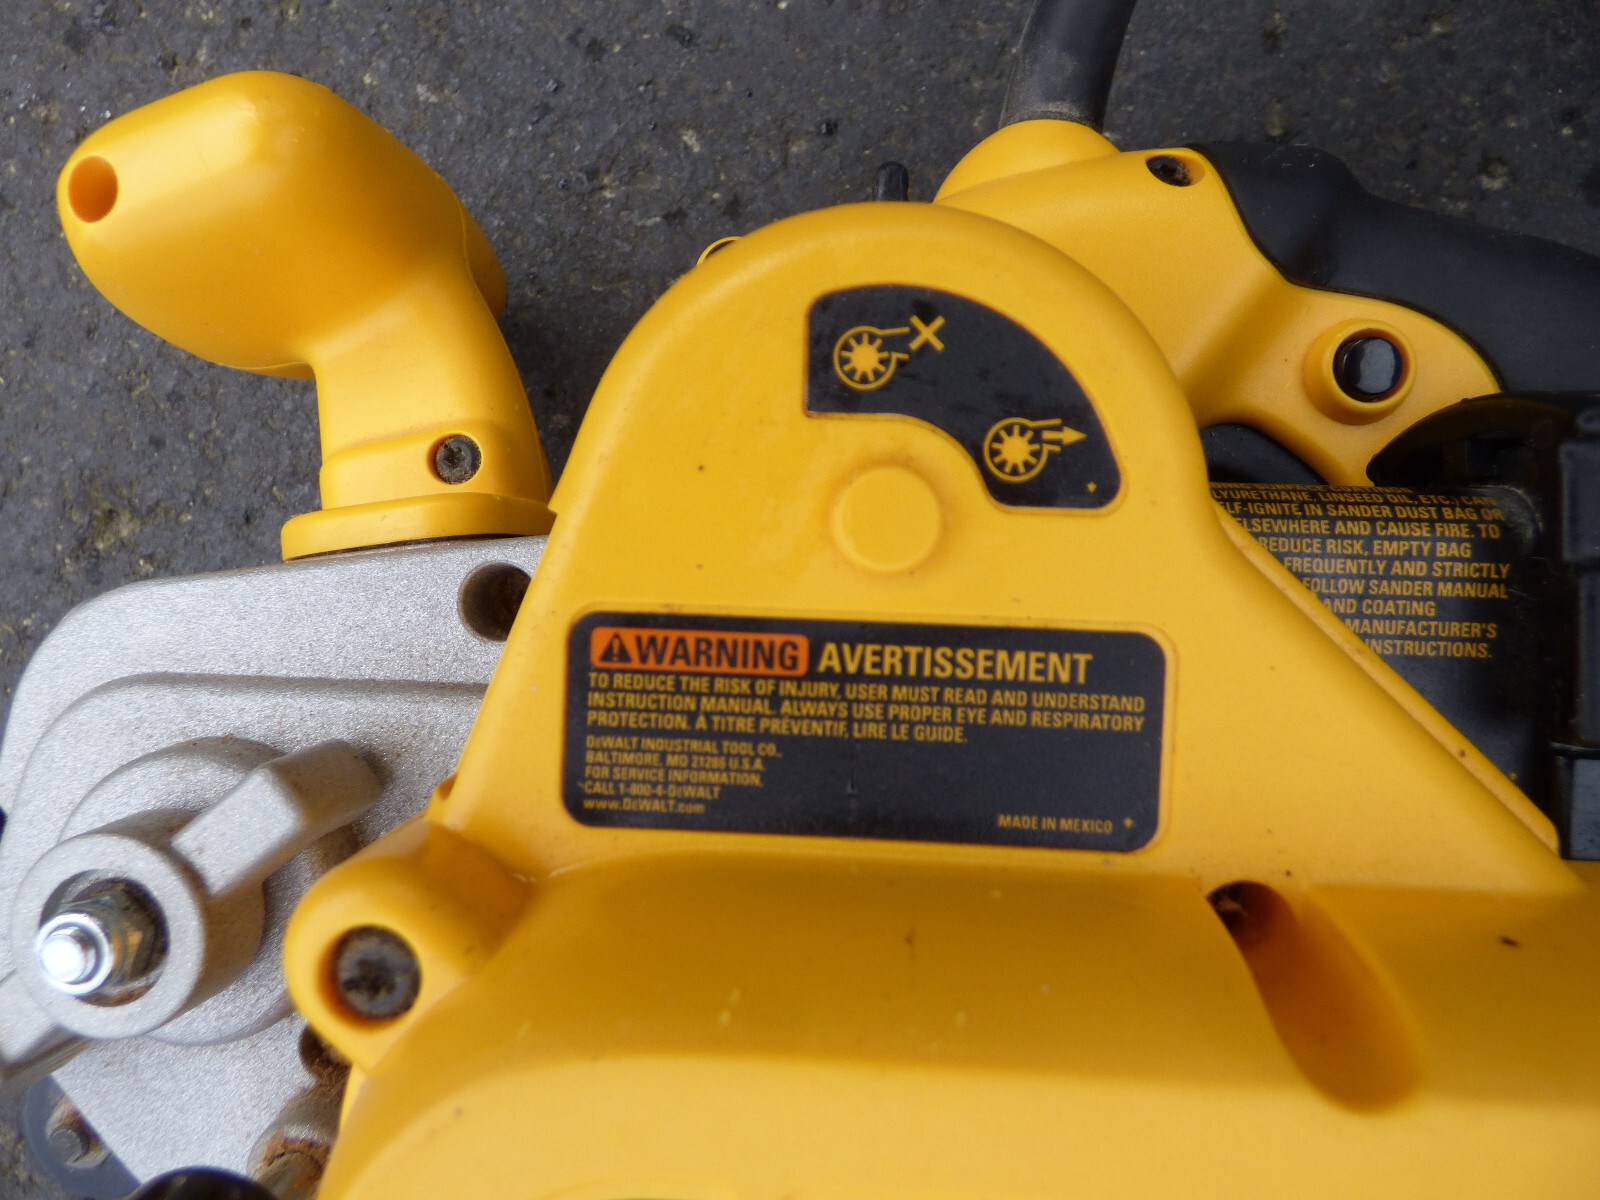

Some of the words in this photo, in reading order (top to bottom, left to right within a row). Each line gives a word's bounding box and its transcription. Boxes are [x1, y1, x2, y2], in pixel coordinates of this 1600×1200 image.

[1319, 491, 1383, 503] LINSEED
[1386, 494, 1418, 504] OIL,
[1303, 503, 1323, 516] IN
[1326, 504, 1392, 518] SANDER
[1394, 506, 1437, 519] DUST
[1441, 507, 1478, 520] BAG
[1480, 508, 1505, 521] OR
[1236, 518, 1330, 535] LSEWHERE
[1335, 520, 1371, 536] AND
[1375, 521, 1431, 537] CAUSE
[1435, 522, 1475, 539] FIRE.
[1477, 524, 1500, 539] TO
[1258, 536, 1321, 553] REDUCE
[1326, 538, 1369, 556] RISK,
[1373, 540, 1431, 557] EMPTY
[1436, 542, 1472, 558] BAG
[1283, 556, 1388, 576] FREQUENTLY
[1390, 560, 1427, 576] AND
[1431, 561, 1510, 579] STRICTLY
[1302, 577, 1365, 594] FOLLOW
[1368, 579, 1433, 596] SANDER
[1437, 581, 1508, 599] MANUAL
[1323, 597, 1357, 614] AND
[1362, 599, 1436, 617] COATING
[1344, 618, 1498, 638] MANUFACTURER'S
[635, 634, 799, 671] WARNING
[816, 642, 1093, 684] AVERTISSEMENT
[588, 672, 609, 689] TO
[612, 673, 676, 692] REDUCE
[679, 675, 710, 693] THE
[713, 677, 750, 695] RISK
[755, 679, 776, 696] OF
[778, 680, 842, 699] INJURY,
[844, 682, 888, 701] USER
[891, 684, 940, 703] MUST
[942, 687, 987, 705] READ
[991, 690, 1027, 708] AND
[1031, 691, 1145, 713] UNDERSTAND
[587, 691, 697, 711] INSTRUCTION
[780, 699, 849, 718] ALWAYS
[851, 702, 884, 720] USE
[888, 703, 952, 723] PROPER
[956, 706, 987, 725] EYE
[991, 709, 1027, 727] AND
[1030, 710, 1144, 732] RESPIRATORY
[586, 710, 692, 730] PROTECTION.
[694, 711, 708, 731] À
[710, 714, 756, 734] TITRE
[758, 714, 849, 738] PRÉVENTIF,
[852, 721, 888, 740] LIRE
[890, 723, 909, 741] LE
[913, 724, 968, 743] GUIDE.
[640, 736, 719, 754] INDUSTRIAL
[722, 739, 755, 756] TOOL
[584, 764, 610, 779] FOR
[612, 766, 665, 783] SERVICE
[584, 780, 615, 795] CALL
[997, 813, 1038, 830] MADE
[1041, 816, 1057, 831] IN
[1059, 817, 1113, 834] MEXICO
